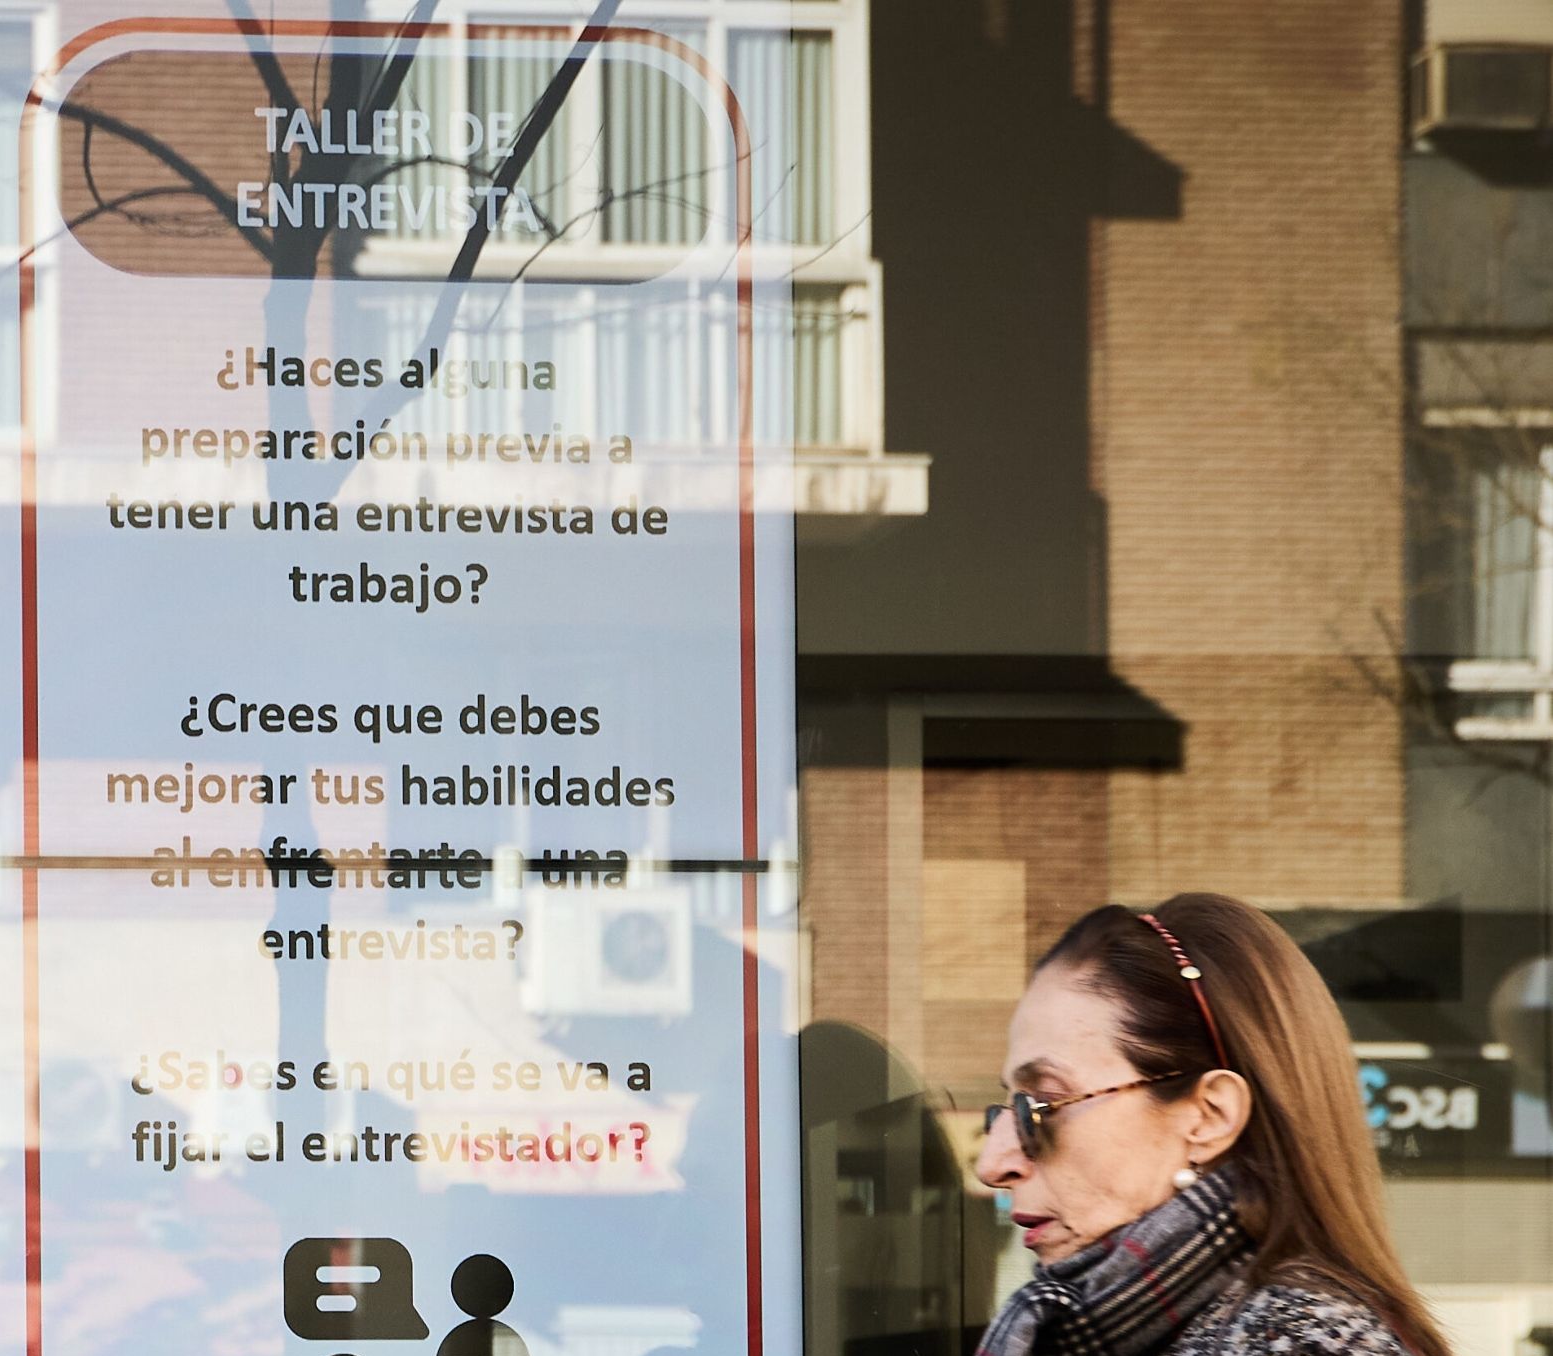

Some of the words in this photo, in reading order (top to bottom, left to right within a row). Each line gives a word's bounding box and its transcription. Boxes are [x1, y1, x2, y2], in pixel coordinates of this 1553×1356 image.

[254, 107, 432, 156] TALLER
[449, 111, 516, 158] DE
[236, 182, 540, 233] ENTREVISTA
[216, 346, 384, 391] ¿Haces
[399, 348, 557, 398] alguna
[141, 419, 427, 467] preparación
[446, 424, 590, 471] previa
[608, 433, 633, 464] a
[106, 491, 235, 530] tener
[251, 499, 339, 533] una
[356, 495, 594, 534] entrevista
[610, 494, 669, 534] de
[289, 562, 488, 614] trabajo?
[180, 693, 338, 737] ¿Crees
[353, 701, 443, 743] que
[458, 695, 600, 736] debes
[107, 765, 296, 814] mejorar
[312, 768, 385, 805] tus
[401, 764, 675, 808] habilidades
[151, 836, 190, 888] al
[208, 836, 483, 889] enfrentarte
[543, 848, 627, 890] una
[257, 919, 524, 962] entrevista?
[131, 1050, 296, 1095] ¿Sabes
[312, 1060, 369, 1092] en
[387, 1050, 476, 1100] qué
[493, 1059, 542, 1093] se
[557, 1058, 609, 1092] va
[627, 1059, 652, 1092] a
[132, 1121, 224, 1171] fijar
[245, 1121, 284, 1163] el
[302, 1121, 652, 1163] entrevistador?
